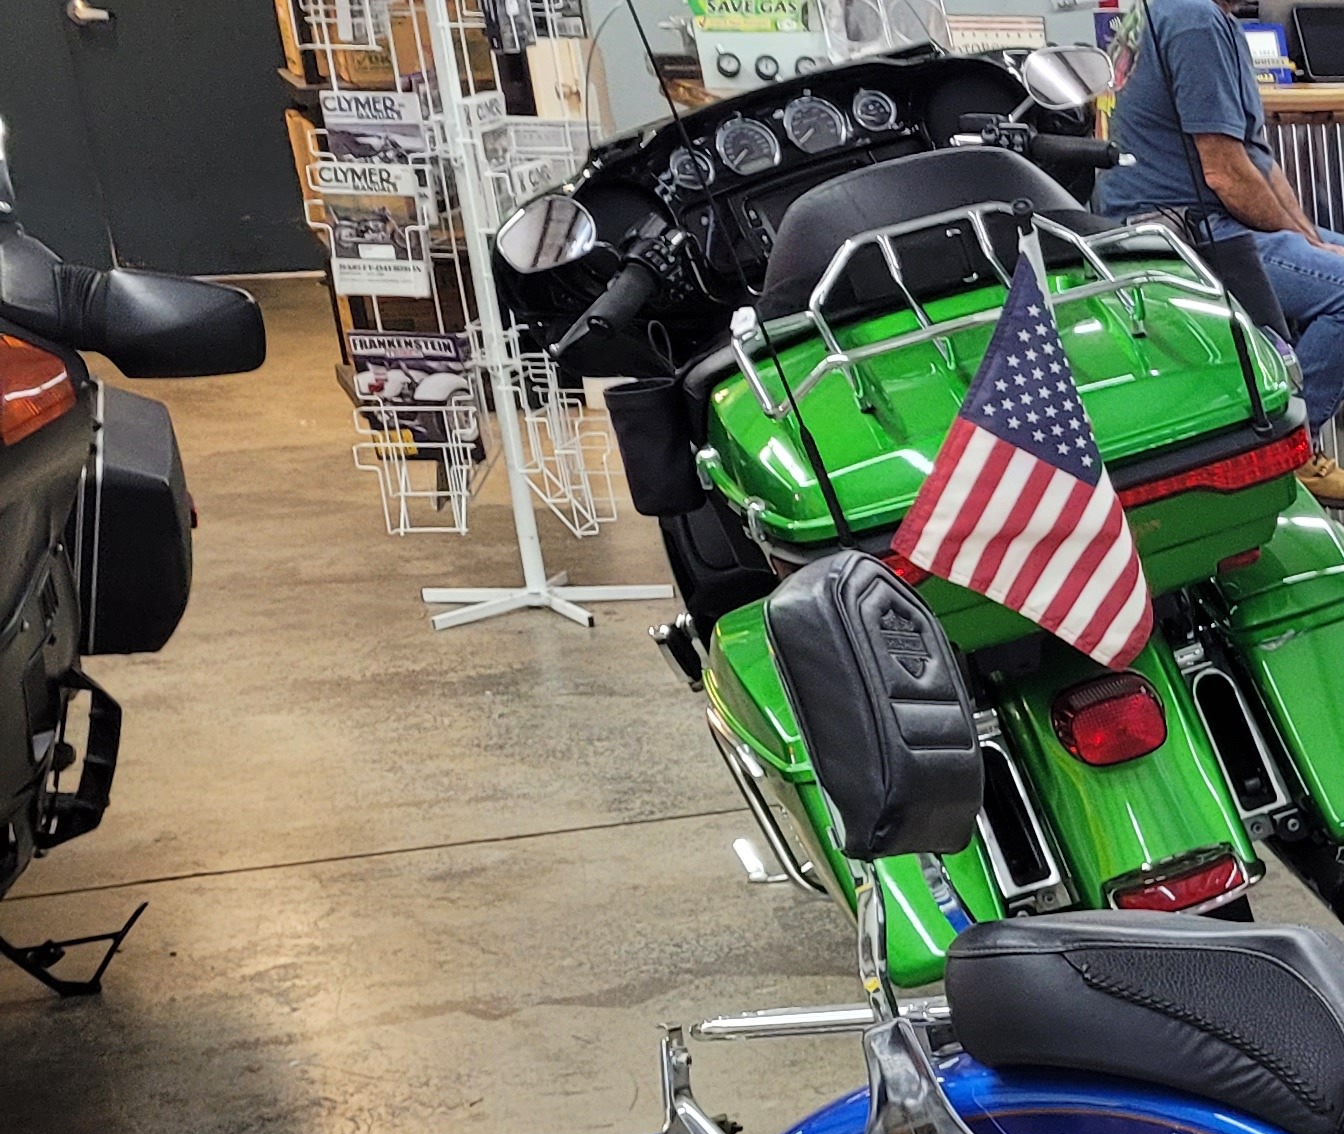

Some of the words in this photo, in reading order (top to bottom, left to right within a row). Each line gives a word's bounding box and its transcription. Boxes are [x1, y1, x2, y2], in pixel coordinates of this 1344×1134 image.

[322, 95, 400, 115] CLYMER
[318, 166, 395, 186] CLYMER
[351, 338, 453, 354] FRANKENSTEIN
